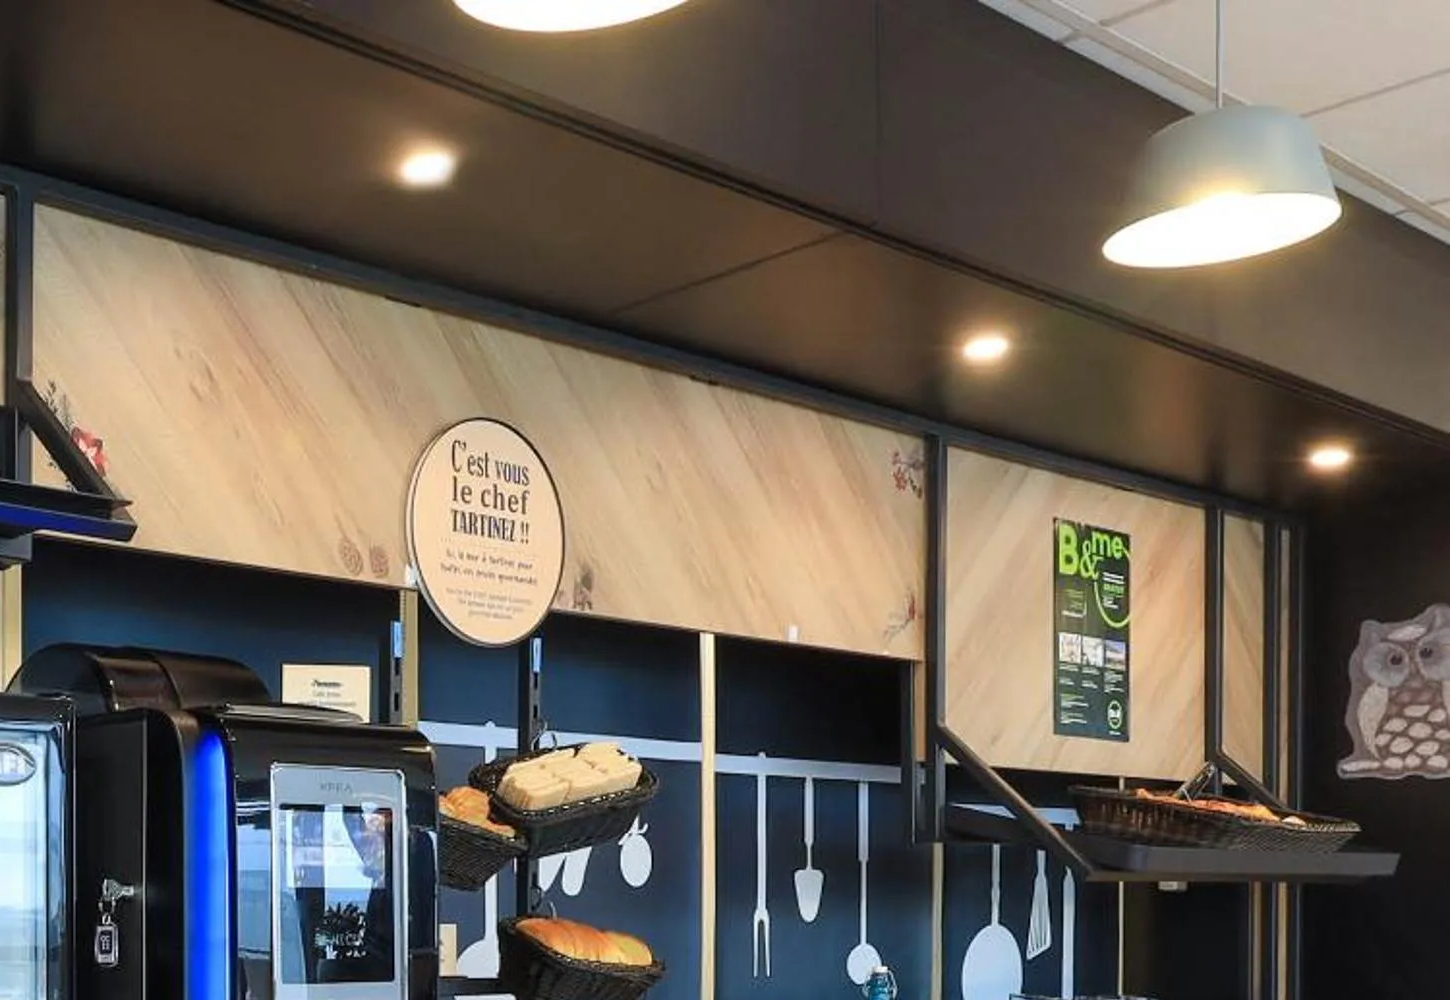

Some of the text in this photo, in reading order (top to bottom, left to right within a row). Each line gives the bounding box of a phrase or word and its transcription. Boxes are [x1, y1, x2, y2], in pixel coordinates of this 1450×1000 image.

[451, 440, 530, 486] C'est vous
[452, 475, 531, 516] le chef
[451, 509, 516, 542] TARTINEZ
